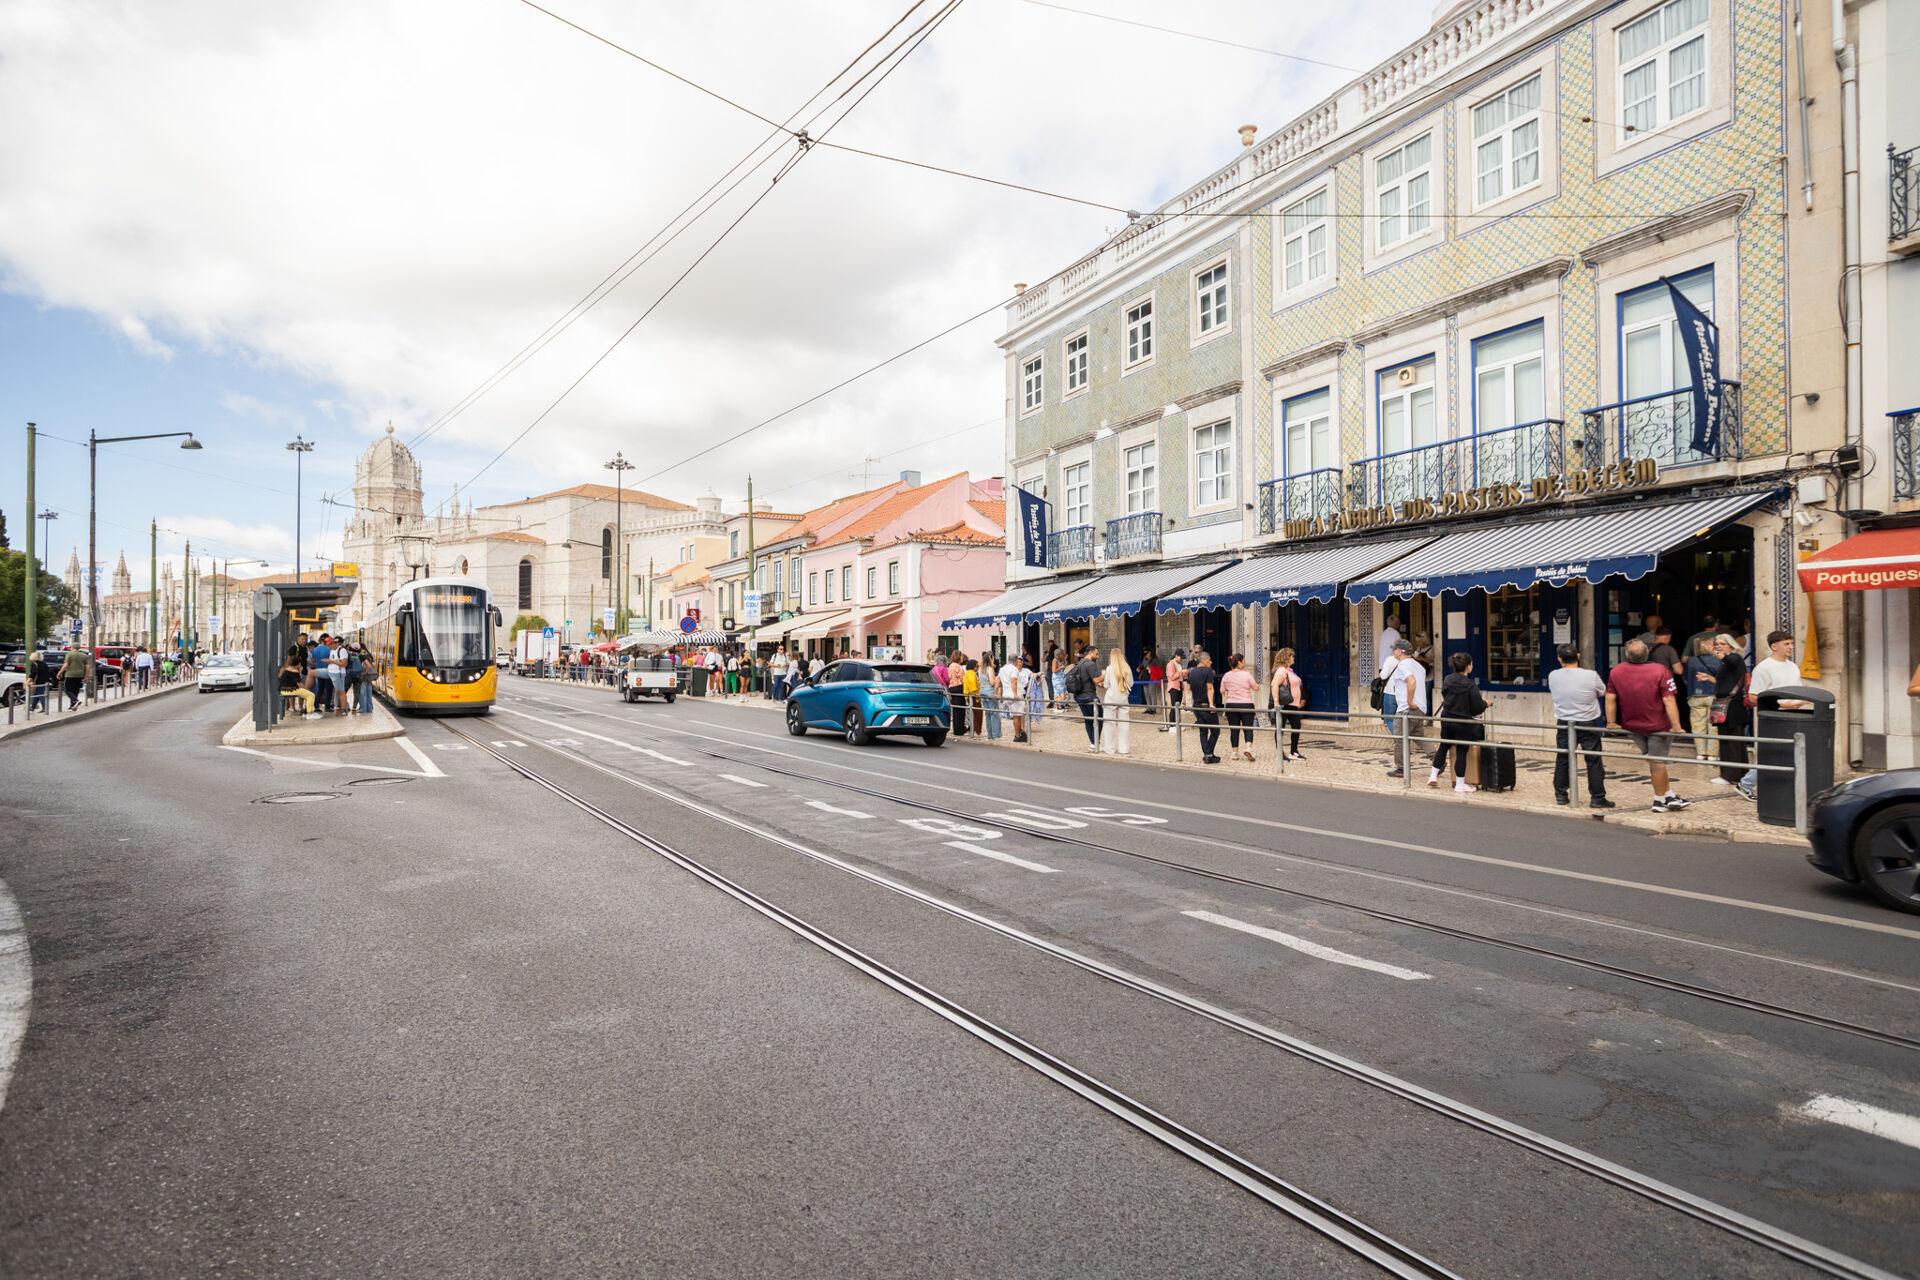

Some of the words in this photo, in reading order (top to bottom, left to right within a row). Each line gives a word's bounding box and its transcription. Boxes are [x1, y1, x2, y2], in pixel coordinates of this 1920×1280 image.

[1706, 372, 1717, 391] de
[1401, 496, 1436, 520] DOS
[1442, 481, 1524, 516] PASTÉIS
[1532, 474, 1564, 501] DE
[1571, 457, 1659, 495] BELÉM
[1033, 530, 1040, 539] de
[1535, 567, 1557, 577] Pastéis
[1557, 566, 1566, 575] de
[1566, 564, 1587, 575] Belém
[1816, 569, 1920, 586] Portugues
[898, 806, 1169, 841] BUS
